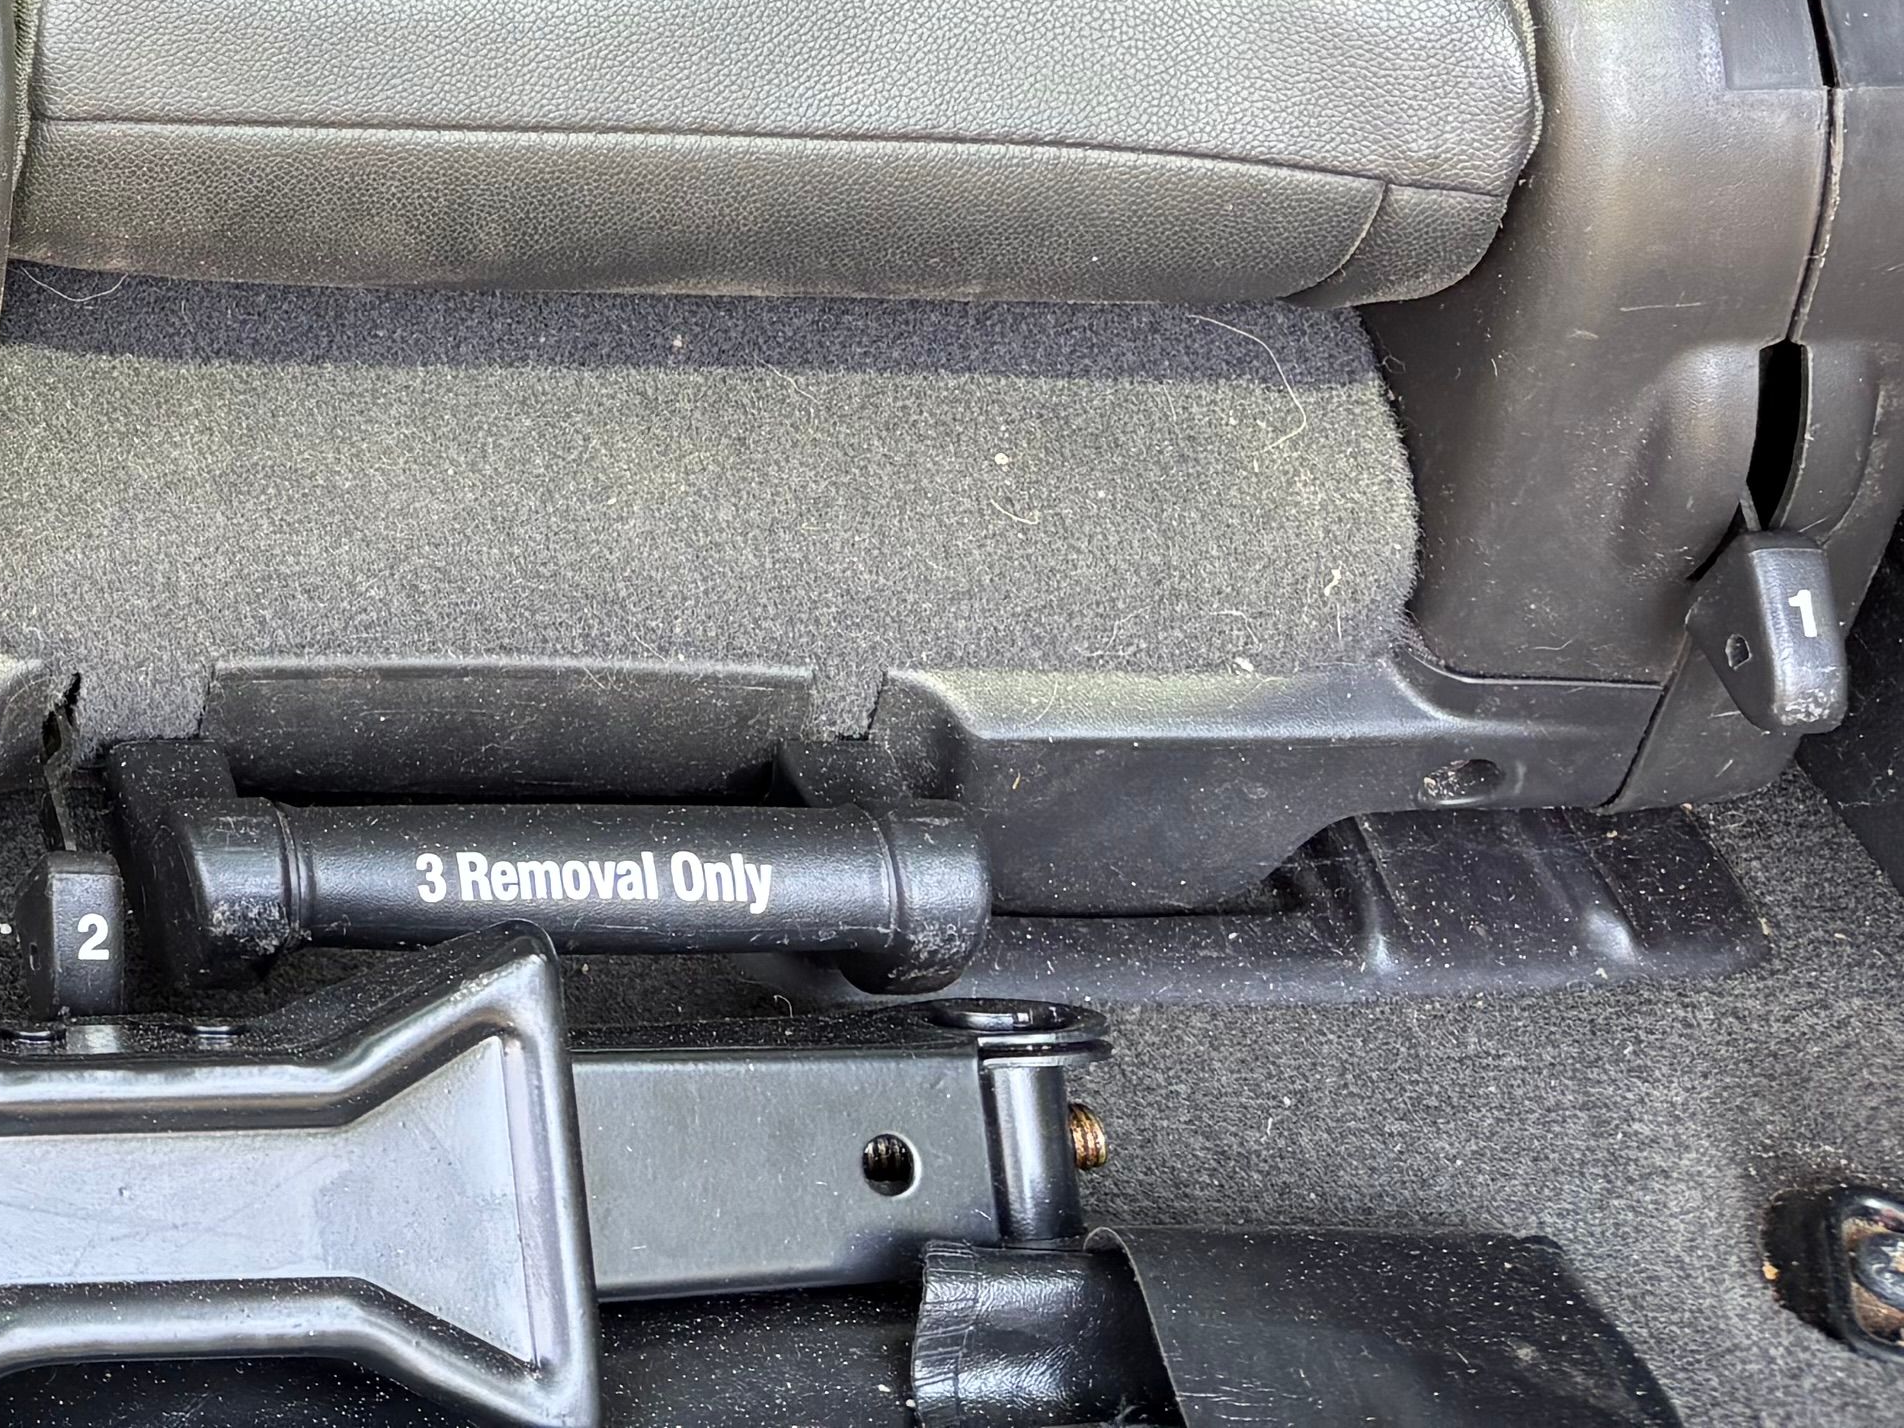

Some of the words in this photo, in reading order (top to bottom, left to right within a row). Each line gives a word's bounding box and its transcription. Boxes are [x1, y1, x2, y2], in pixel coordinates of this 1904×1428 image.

[1788, 589, 1818, 638] 1
[415, 853, 447, 903] 3
[456, 851, 658, 902] Removal
[670, 851, 773, 914] Only
[76, 913, 110, 960] 2
